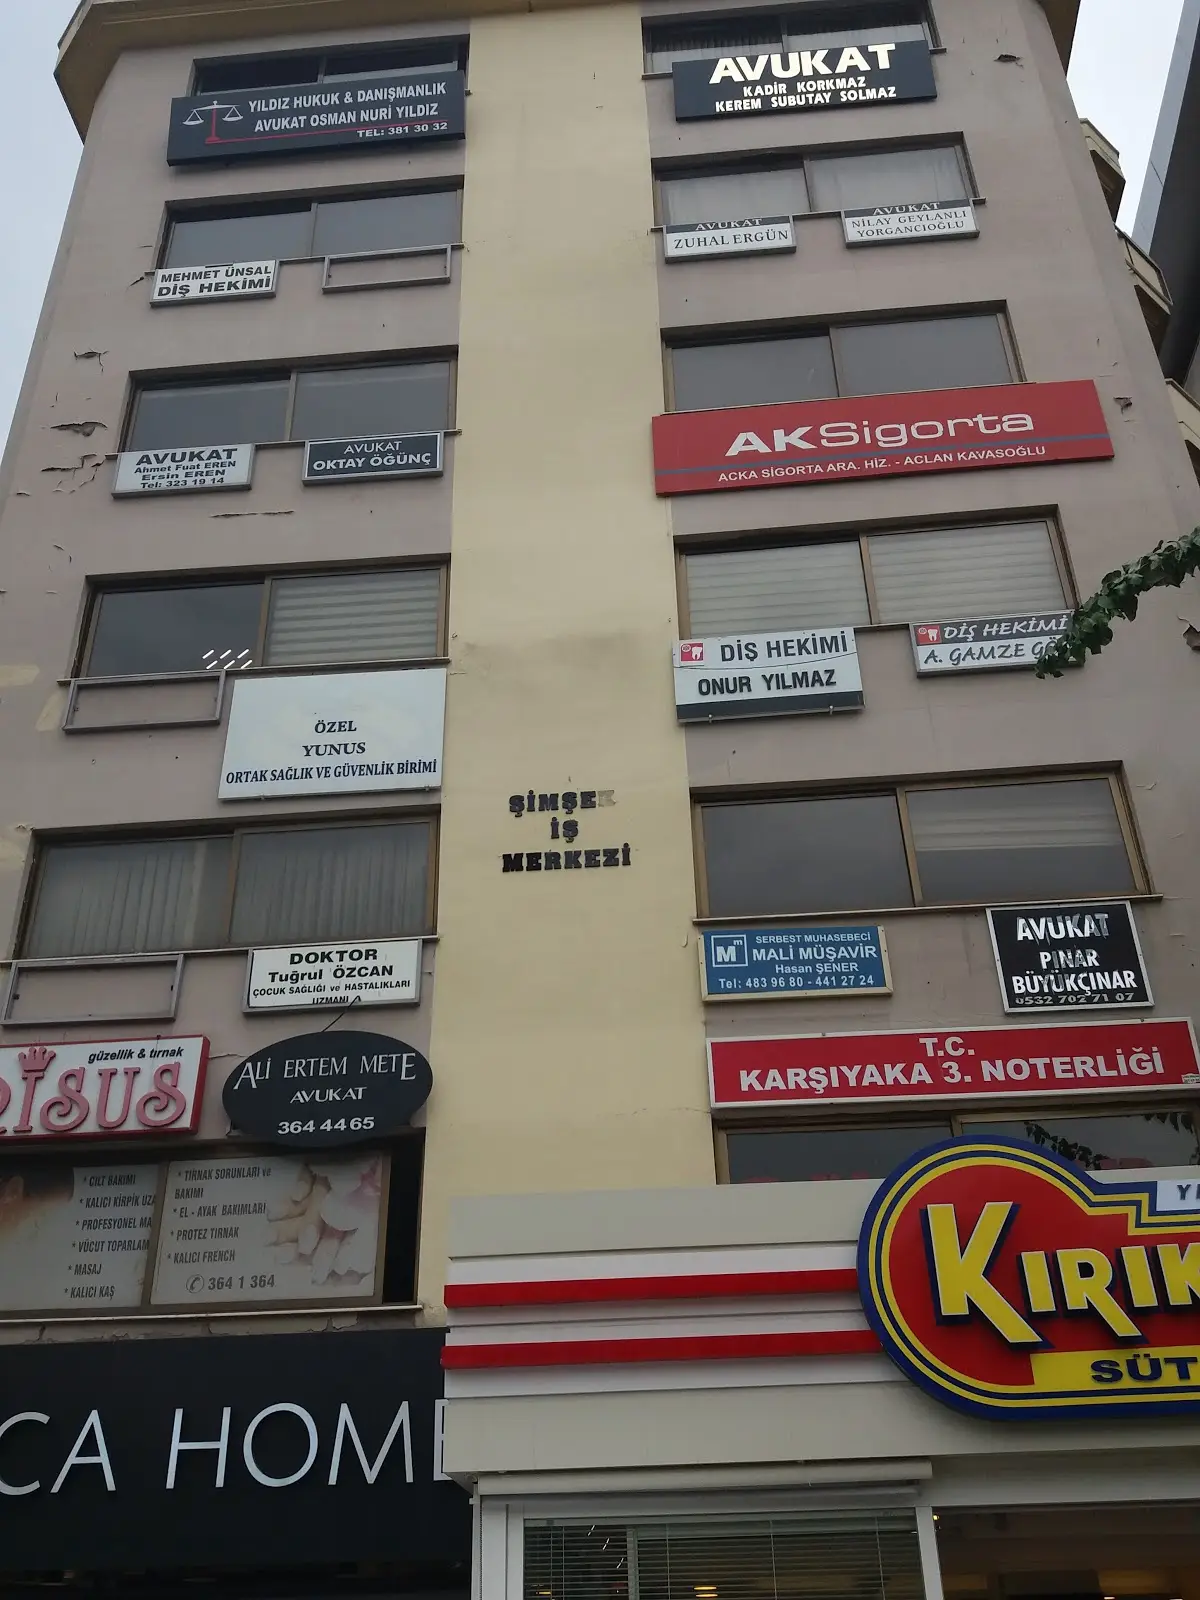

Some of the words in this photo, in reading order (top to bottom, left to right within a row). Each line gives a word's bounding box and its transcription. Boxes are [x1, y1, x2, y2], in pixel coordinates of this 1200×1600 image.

[709, 43, 896, 84] AVUKAT
[743, 81, 787, 97] KADİR
[797, 76, 866, 93] KORKMAZ
[249, 99, 289, 113] YILDIZ
[293, 92, 340, 109] HUKUK
[343, 91, 353, 104] &
[357, 82, 446, 103] DANIŞMANLIK
[716, 99, 762, 112] KEREM
[771, 92, 832, 108] SUBUTAY
[840, 87, 896, 102] SOLMAZ
[254, 116, 307, 132] AVUKAT
[310, 110, 355, 127] OSMAN
[360, 104, 392, 122] NURİ
[395, 103, 438, 118] YILDIZ
[357, 129, 385, 138] TEL:
[388, 126, 409, 135] 381
[413, 123, 428, 133] 30
[433, 122, 448, 131] 32
[873, 202, 940, 215] AVUKAT
[695, 218, 762, 231] AVUKAT
[852, 217, 892, 228] NİLAY
[898, 211, 967, 224] GEYLANLI
[857, 221, 964, 237] YORGANCIOĞLU
[674, 235, 729, 249] ZUHAL
[733, 230, 788, 244] ERGÜN
[161, 270, 220, 282] MEHMET
[225, 266, 272, 278] ÜNSAL
[158, 284, 190, 298] DİŞ
[199, 276, 270, 293] HEKİMİ
[725, 411, 1035, 457] AKSigorta
[344, 441, 402, 454] AVUKAT
[136, 448, 238, 466] AVUKAT
[313, 458, 366, 470] OKTAY
[370, 452, 431, 466] ÖĞÜNÇ
[718, 470, 758, 482] ACKA
[761, 465, 824, 478] SİGORTA
[826, 461, 861, 472] ARA.
[865, 458, 891, 468] HİZ.
[904, 453, 953, 465] ACLAN
[957, 446, 1046, 461] KAVASOĞLU
[134, 465, 171, 474] Ahmet
[184, 469, 226, 478] EREN
[944, 622, 978, 642] DİŞ
[983, 615, 1068, 636] HEKİMİ
[720, 640, 759, 662] DİŞ
[766, 630, 848, 658] HEKİMİ
[924, 649, 942, 664] A.
[950, 643, 1025, 665] GAMZE
[698, 676, 752, 696] ONUR
[761, 669, 837, 691] YILMAZ
[314, 720, 357, 734] ÖZEL
[302, 742, 366, 757] YUNUS
[226, 770, 268, 784] ORTAK
[270, 766, 313, 782] SAĞLIK
[317, 766, 331, 778] VE
[333, 761, 395, 778] GÜVENLİK
[396, 758, 437, 775] BİRİMİ
[551, 816, 578, 843] İŞ
[502, 843, 631, 873] MERKEZİ
[1017, 913, 1109, 941] AVUKAT
[755, 935, 801, 944] SERBEST
[804, 932, 871, 943] MUHASEBECİ
[290, 949, 378, 965] DOKTOR
[753, 946, 794, 961] MALİ
[799, 943, 878, 962] MÜŞAVİR
[1039, 949, 1100, 970] PINAR
[268, 969, 323, 984] Tuğrul
[333, 965, 393, 978] ÖZCAN
[775, 964, 812, 974] Hasan
[816, 963, 859, 974] ŞENER
[253, 987, 286, 998] ÇOCUK
[288, 985, 326, 994] SAĞLIĞI
[344, 980, 410, 991] HASTALIKLARI
[719, 978, 742, 988] Tel:
[746, 978, 767, 988] 483
[771, 977, 785, 987] 96
[789, 977, 803, 987] 80
[815, 977, 836, 987] 441
[842, 976, 855, 986] 27
[859, 975, 874, 985] 24
[1012, 969, 1138, 996] BÜYÜKÇINAR
[312, 996, 349, 1005] UZMANI
[1058, 994, 1087, 1004] 702
[1091, 993, 1109, 1002] 71
[1115, 992, 1134, 1001] 07
[919, 1036, 975, 1057] T.C.
[88, 1049, 134, 1064] güzellik
[138, 1049, 146, 1059] &
[149, 1046, 184, 1058] tırnak
[284, 1056, 347, 1078] ERTEM
[360, 1053, 416, 1080] METE
[739, 1062, 933, 1094] KARŞIYAKA
[941, 1061, 972, 1083] 3.
[980, 1046, 1164, 1082] NOTERLİĞİ
[290, 1087, 368, 1103] AVUKAT
[278, 1121, 315, 1134] 364
[108, 1174, 136, 1186] BAKIMI
[185, 1168, 213, 1181] TIRNAK
[215, 1166, 260, 1180] SORUNLARI
[261, 1167, 272, 1176] ve
[85, 1197, 111, 1208] KALICI
[113, 1193, 140, 1207] KİRPİK
[175, 1188, 204, 1199] BAKIMI
[179, 1207, 189, 1218] EL
[197, 1205, 217, 1217] AYAK
[222, 1203, 266, 1215] BAKIMLARI
[81, 1218, 137, 1230] PROFESYONEL
[176, 1228, 208, 1240] PROTEZ
[210, 1227, 239, 1239] TIRNAK
[78, 1239, 105, 1252] VÜCUT
[173, 1252, 200, 1264] KALICI
[202, 1250, 235, 1263] FRENCH
[74, 1264, 102, 1275] MASAJ
[208, 1277, 233, 1290] 364
[250, 1275, 275, 1288] 364
[70, 1287, 96, 1298] KALICI
[99, 1286, 115, 1300] KAŞ
